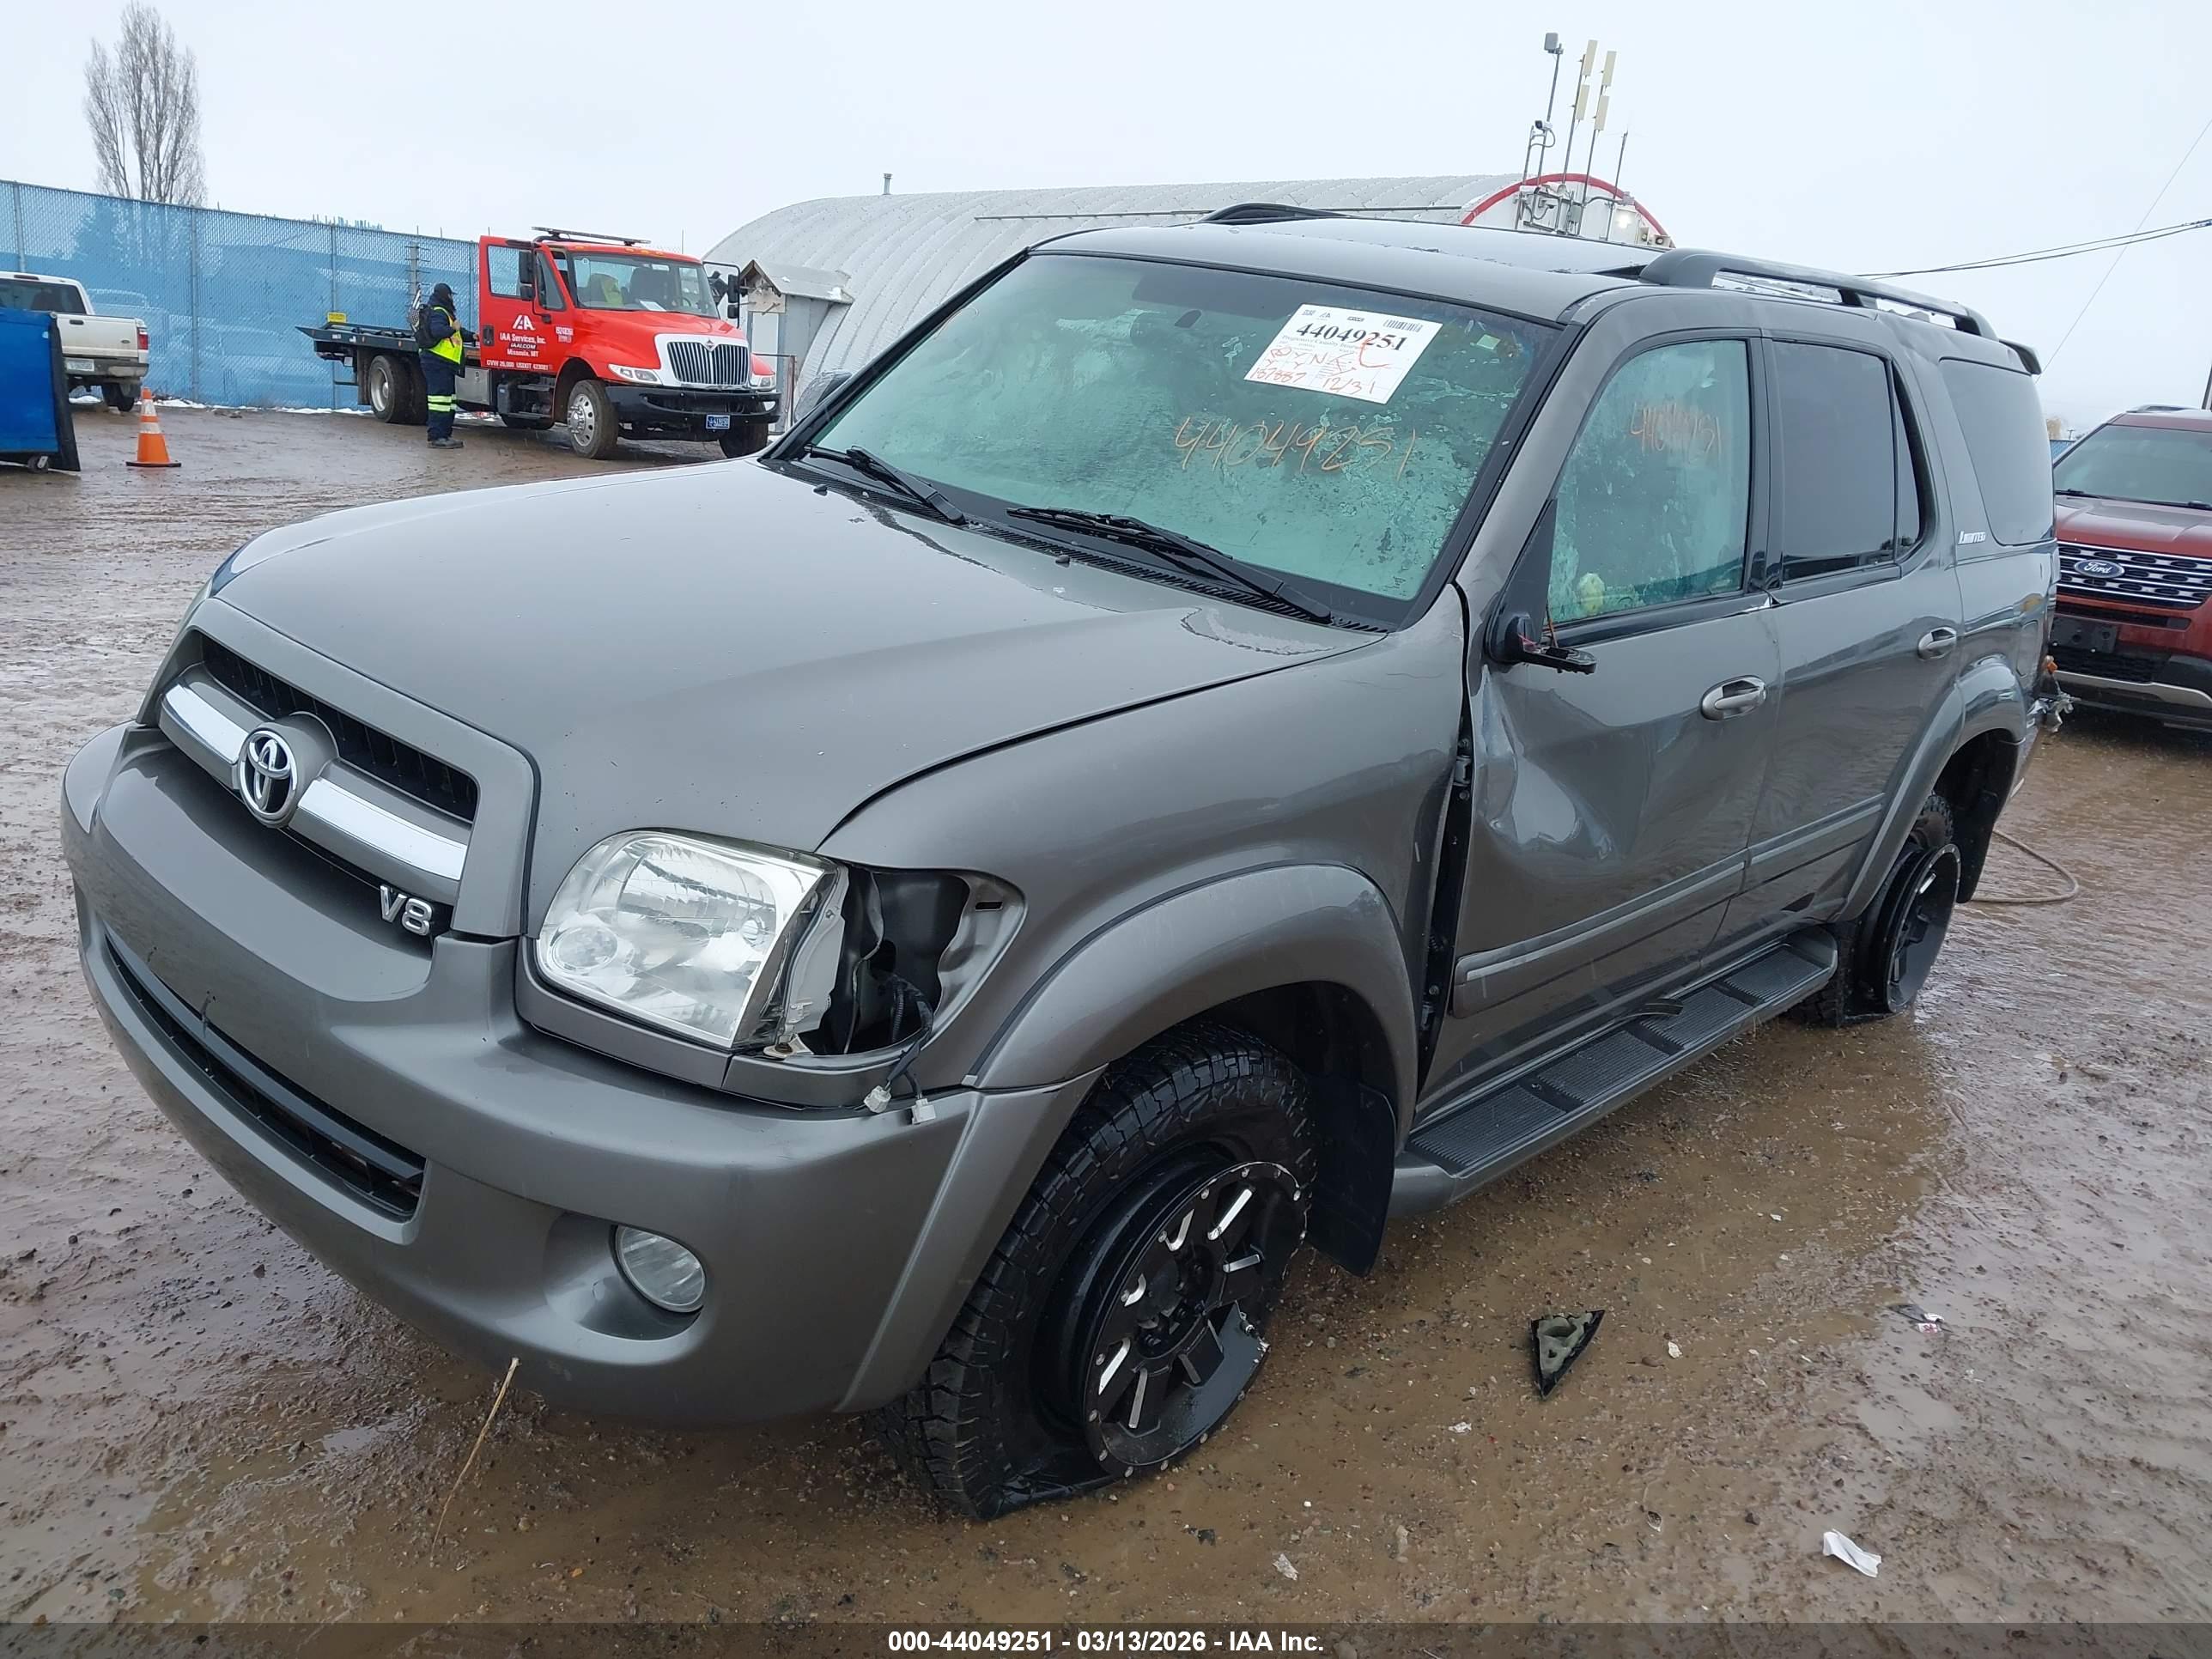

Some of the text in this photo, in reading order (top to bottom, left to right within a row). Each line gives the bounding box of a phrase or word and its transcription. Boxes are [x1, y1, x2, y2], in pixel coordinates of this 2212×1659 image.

[500, 332, 511, 342] IAA
[1297, 323, 1407, 351] 44049251
[1176, 416, 1415, 481] 44049251
[380, 885, 432, 936] V8
